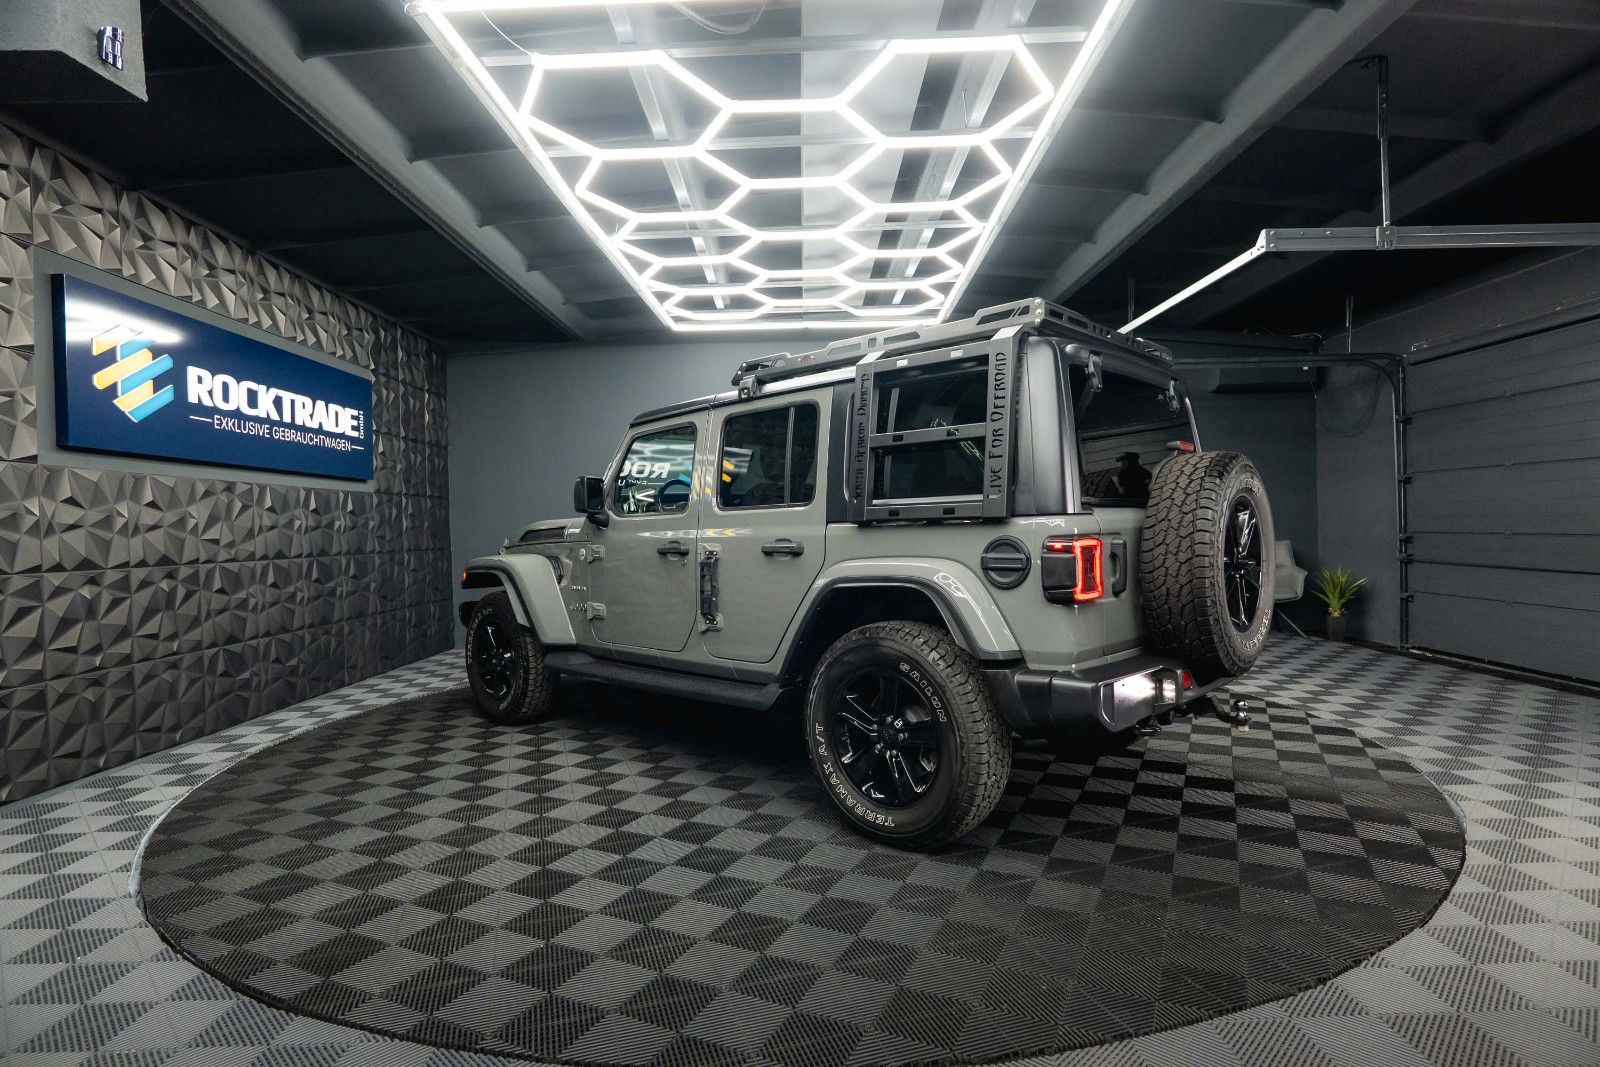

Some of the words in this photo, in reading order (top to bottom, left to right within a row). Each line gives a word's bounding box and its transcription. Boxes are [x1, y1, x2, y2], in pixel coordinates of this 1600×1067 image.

[186, 365, 359, 438] ROCKTRADE
[213, 415, 270, 438] EXKLUSIVE
[272, 427, 352, 452] GEBRAUCHTWAGEN
[900, 662, 947, 723] SAILUN
[815, 722, 828, 756] A/T
[823, 762, 895, 827] TERRAMAX
